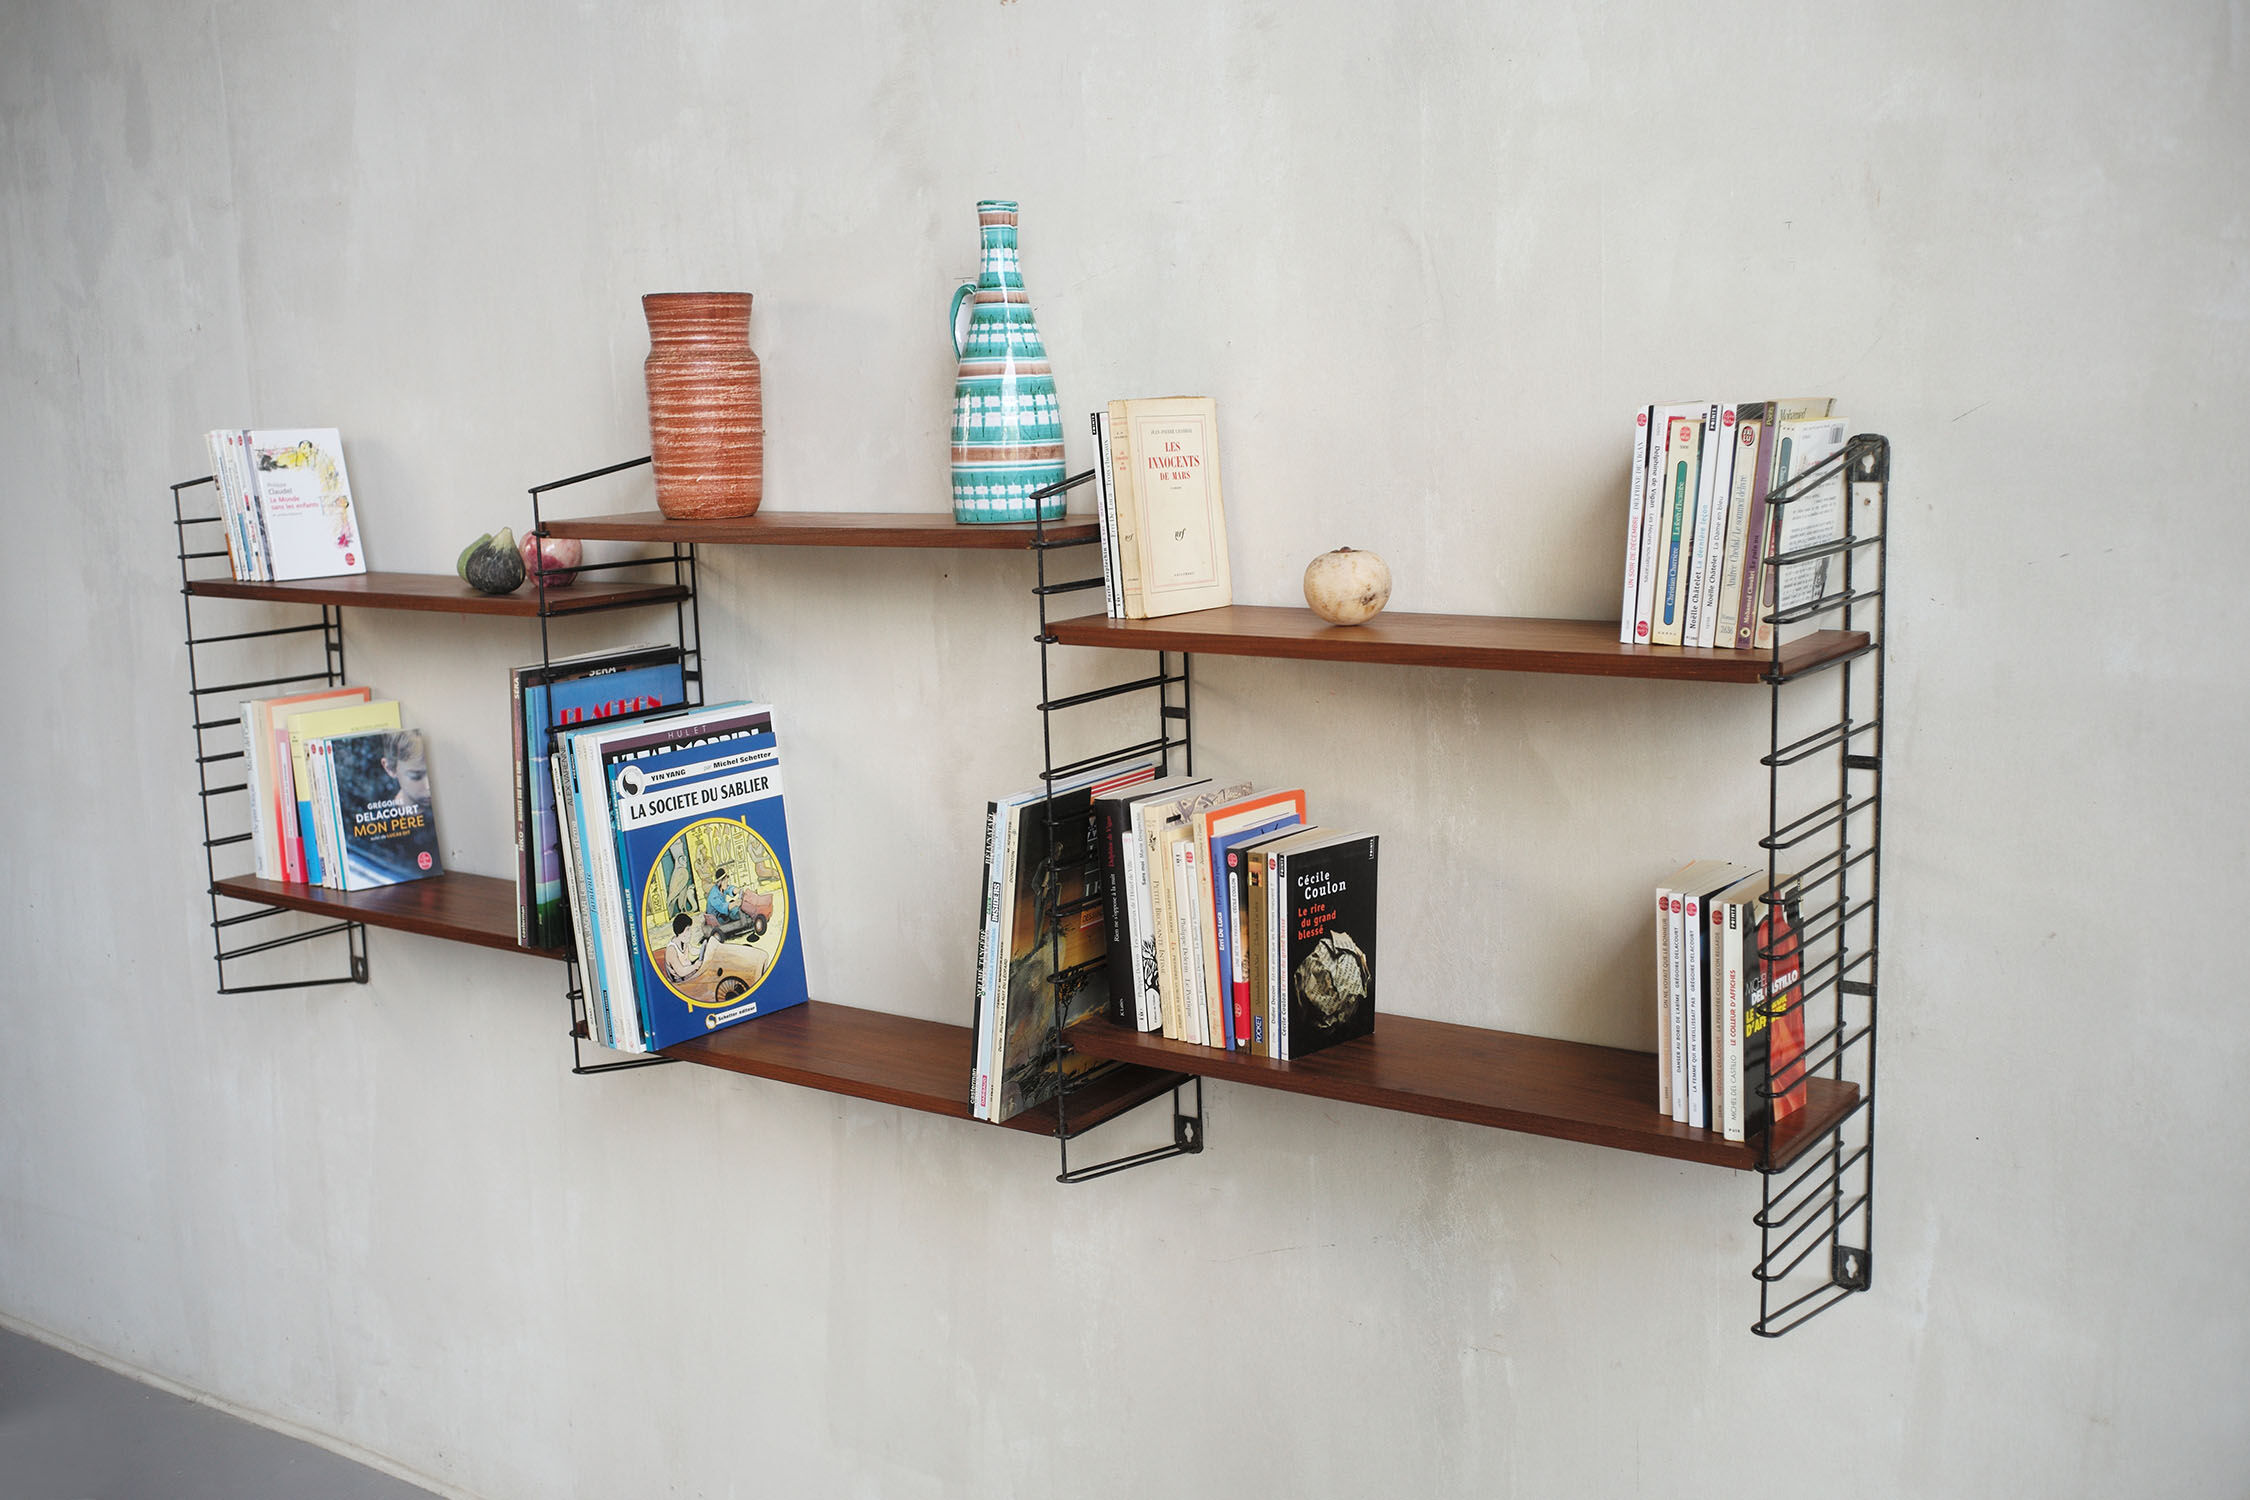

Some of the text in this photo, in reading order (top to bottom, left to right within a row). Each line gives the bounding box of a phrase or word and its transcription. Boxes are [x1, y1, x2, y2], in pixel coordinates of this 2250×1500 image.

[1765, 405, 1775, 426] Points
[1165, 441, 1181, 453] LES
[1148, 455, 1200, 469] INNOCENTS
[1160, 471, 1191, 480] DE MARS
[1649, 445, 1661, 508] Delphine de Vigan
[1716, 511, 1723, 521] en
[1696, 504, 1709, 569] La dernière leçon
[1714, 521, 1722, 540] Dame
[1713, 541, 1719, 550] La
[1692, 571, 1702, 603] Châtelet
[1707, 554, 1718, 607] Noëlle Châtelet
[1689, 605, 1699, 629] Noëlle
[667, 723, 708, 741] HULET
[712, 757, 739, 769] Michel
[739, 749, 772, 763] Schetter
[558, 744, 575, 807] ALEX VARENNE
[650, 768, 686, 782] YIN YANG
[628, 772, 771, 821] LA SOCIETE DU SABLIER
[355, 804, 419, 824] DELACOURT
[353, 814, 425, 838] MON PÈRE
[1110, 873, 1118, 886] nuit
[1297, 870, 1330, 888] Cécile
[585, 871, 599, 915] farniente
[1304, 880, 1347, 900] Coulon
[991, 882, 1001, 922] INSIDERS
[1112, 896, 1120, 919] s'oppose
[1298, 903, 1326, 917] Le rire
[625, 887, 639, 955] LA SOCIETE DU SABLIER
[1300, 910, 1337, 928] du grand
[1218, 929, 1224, 937] De
[1298, 924, 1324, 940] blessé
[1281, 960, 1286, 968] du
[1281, 984, 1287, 992] Le
[1675, 1015, 1681, 1024] DE
[1255, 1015, 1263, 1043] POCKET
[1676, 1041, 1681, 1050] AU
[1691, 1043, 1697, 1051] NE
[1731, 1038, 1737, 1046] LE
[970, 1067, 978, 1104] casterman
[1692, 1085, 1697, 1093] LA
